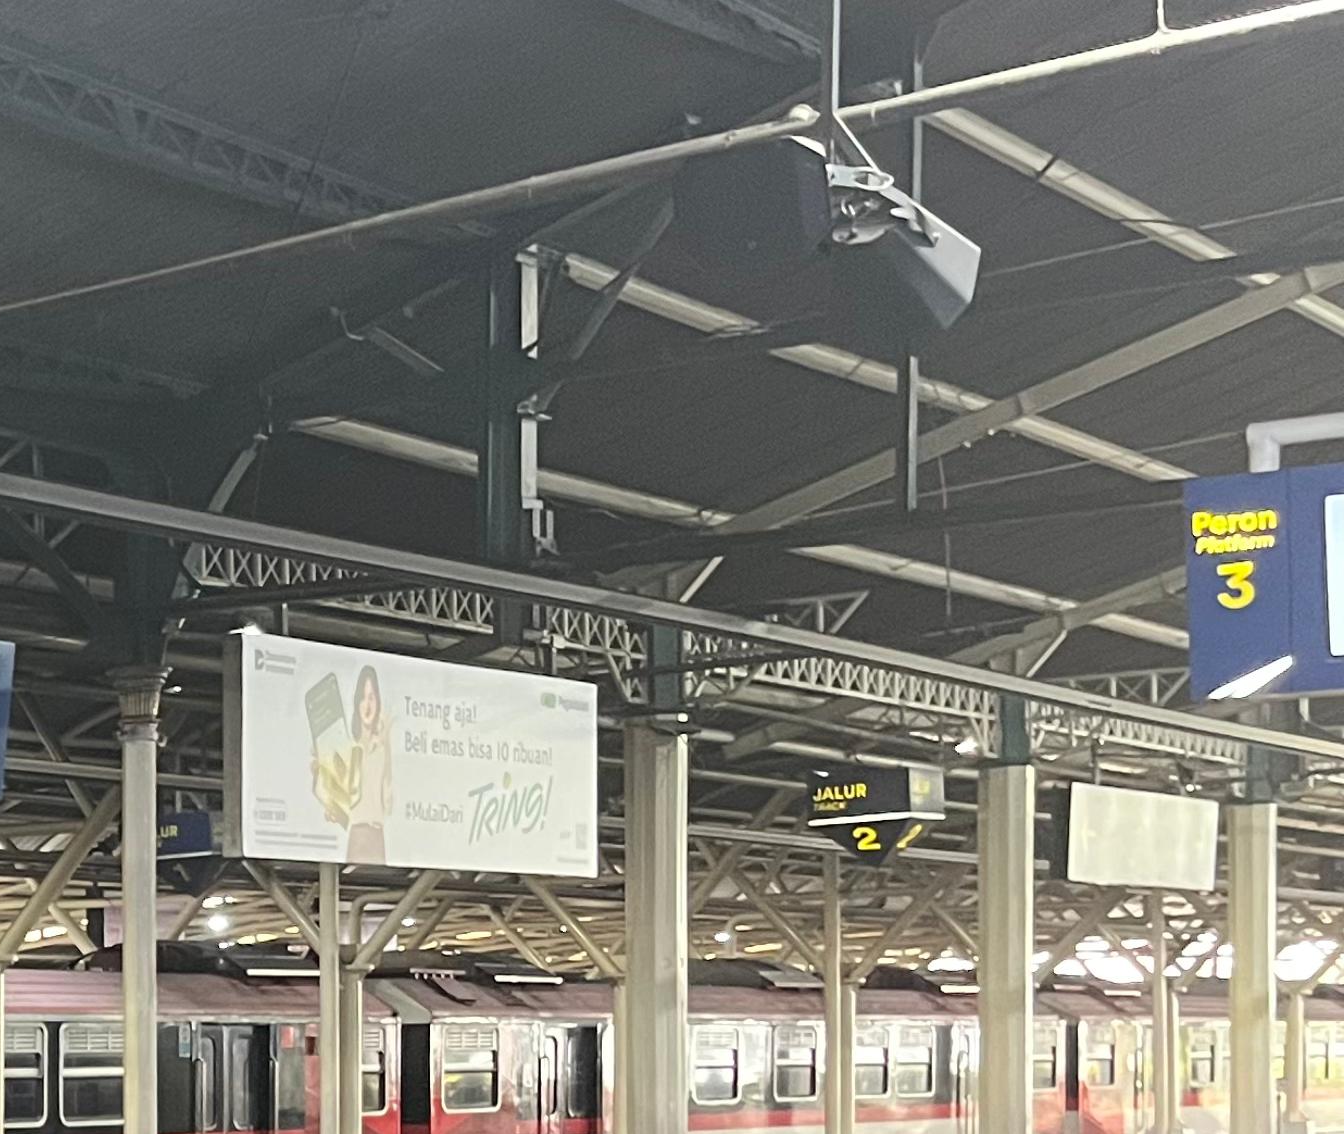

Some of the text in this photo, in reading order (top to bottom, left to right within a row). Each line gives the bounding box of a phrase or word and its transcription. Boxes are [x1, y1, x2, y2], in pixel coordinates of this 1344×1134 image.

[1192, 510, 1277, 537] Peron
[1216, 560, 1255, 610] 3
[404, 695, 478, 730] Tenang aja!
[404, 731, 428, 754] Beli
[431, 738, 465, 757] emas
[468, 737, 493, 761] bisa
[812, 783, 867, 802] JALUR
[852, 826, 881, 851] 2
